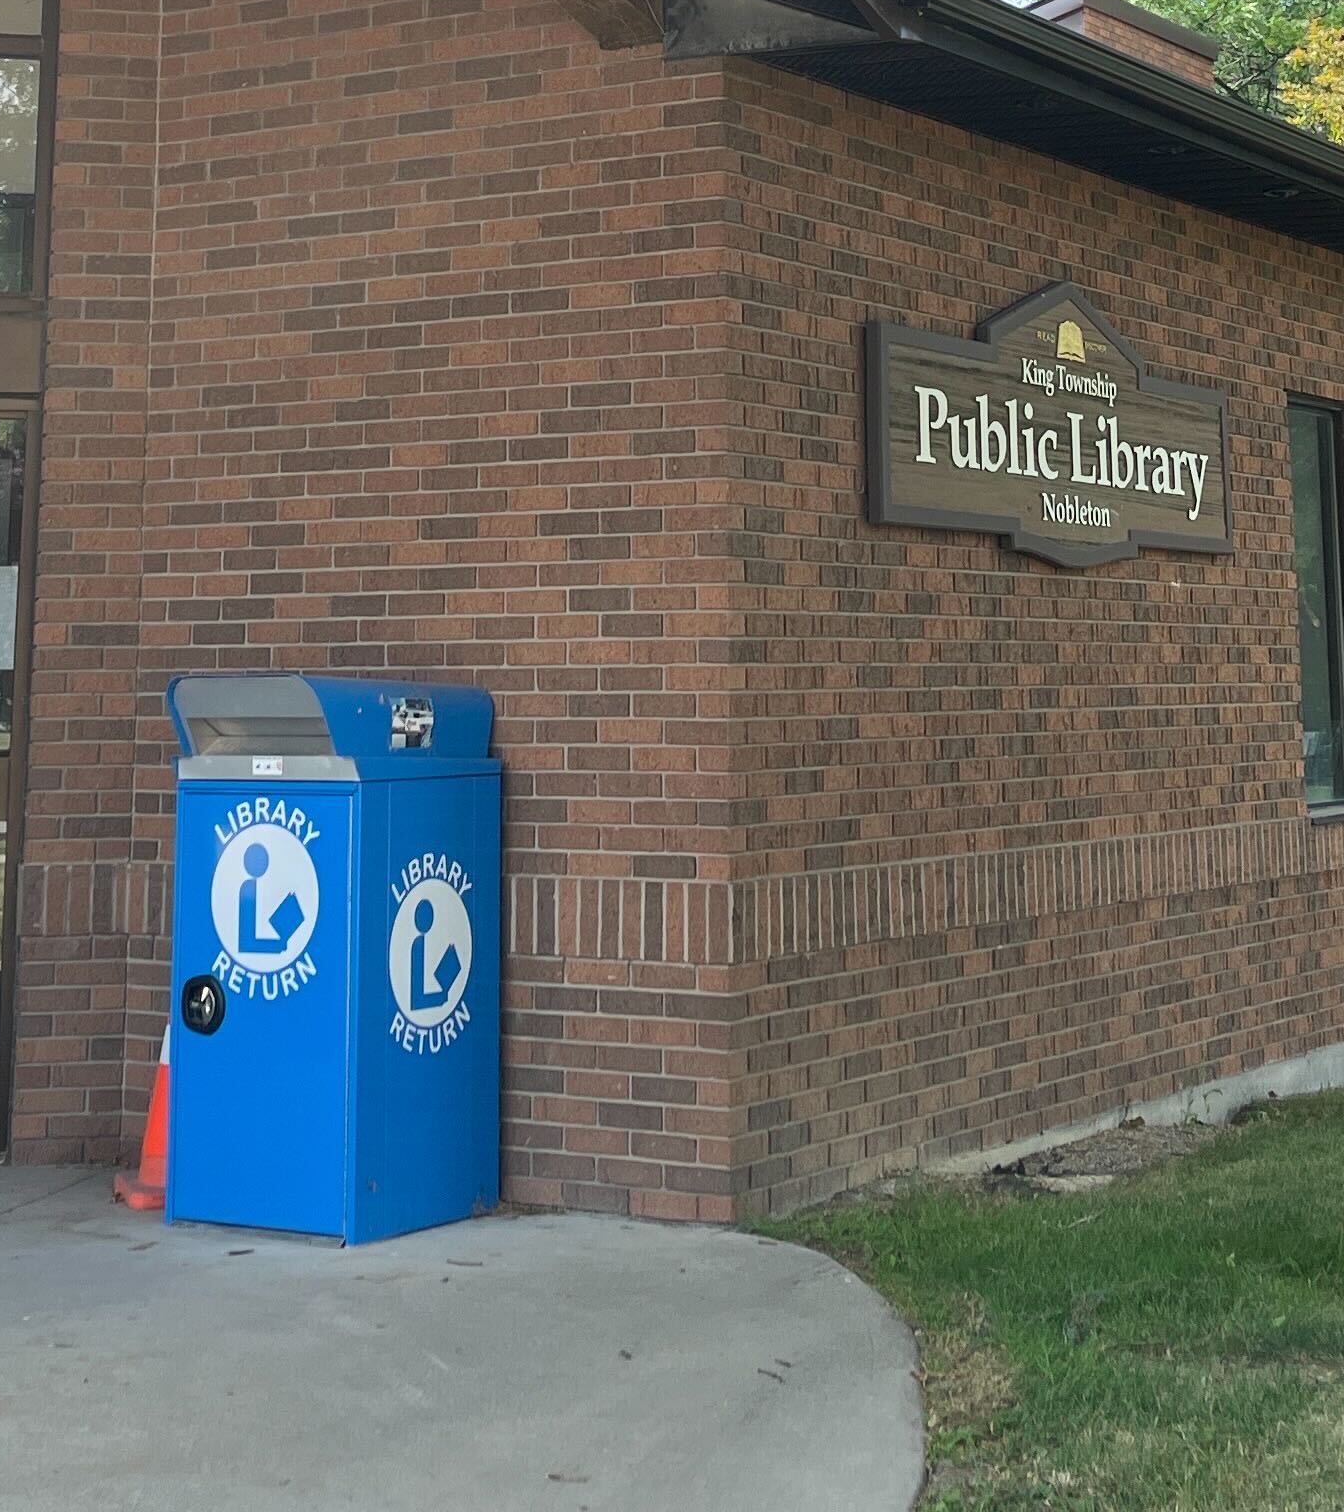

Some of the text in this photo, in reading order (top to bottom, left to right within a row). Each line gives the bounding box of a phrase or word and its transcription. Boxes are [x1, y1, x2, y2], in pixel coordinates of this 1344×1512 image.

[1021, 357, 1117, 408] King Township
[914, 385, 1209, 521] Public Library
[1041, 492, 1111, 528] Nobleton
[213, 796, 321, 846] LIBRARY
[391, 852, 473, 903] LIBRARY
[211, 950, 318, 1001] RETURN
[389, 1000, 471, 1055] RETURN
